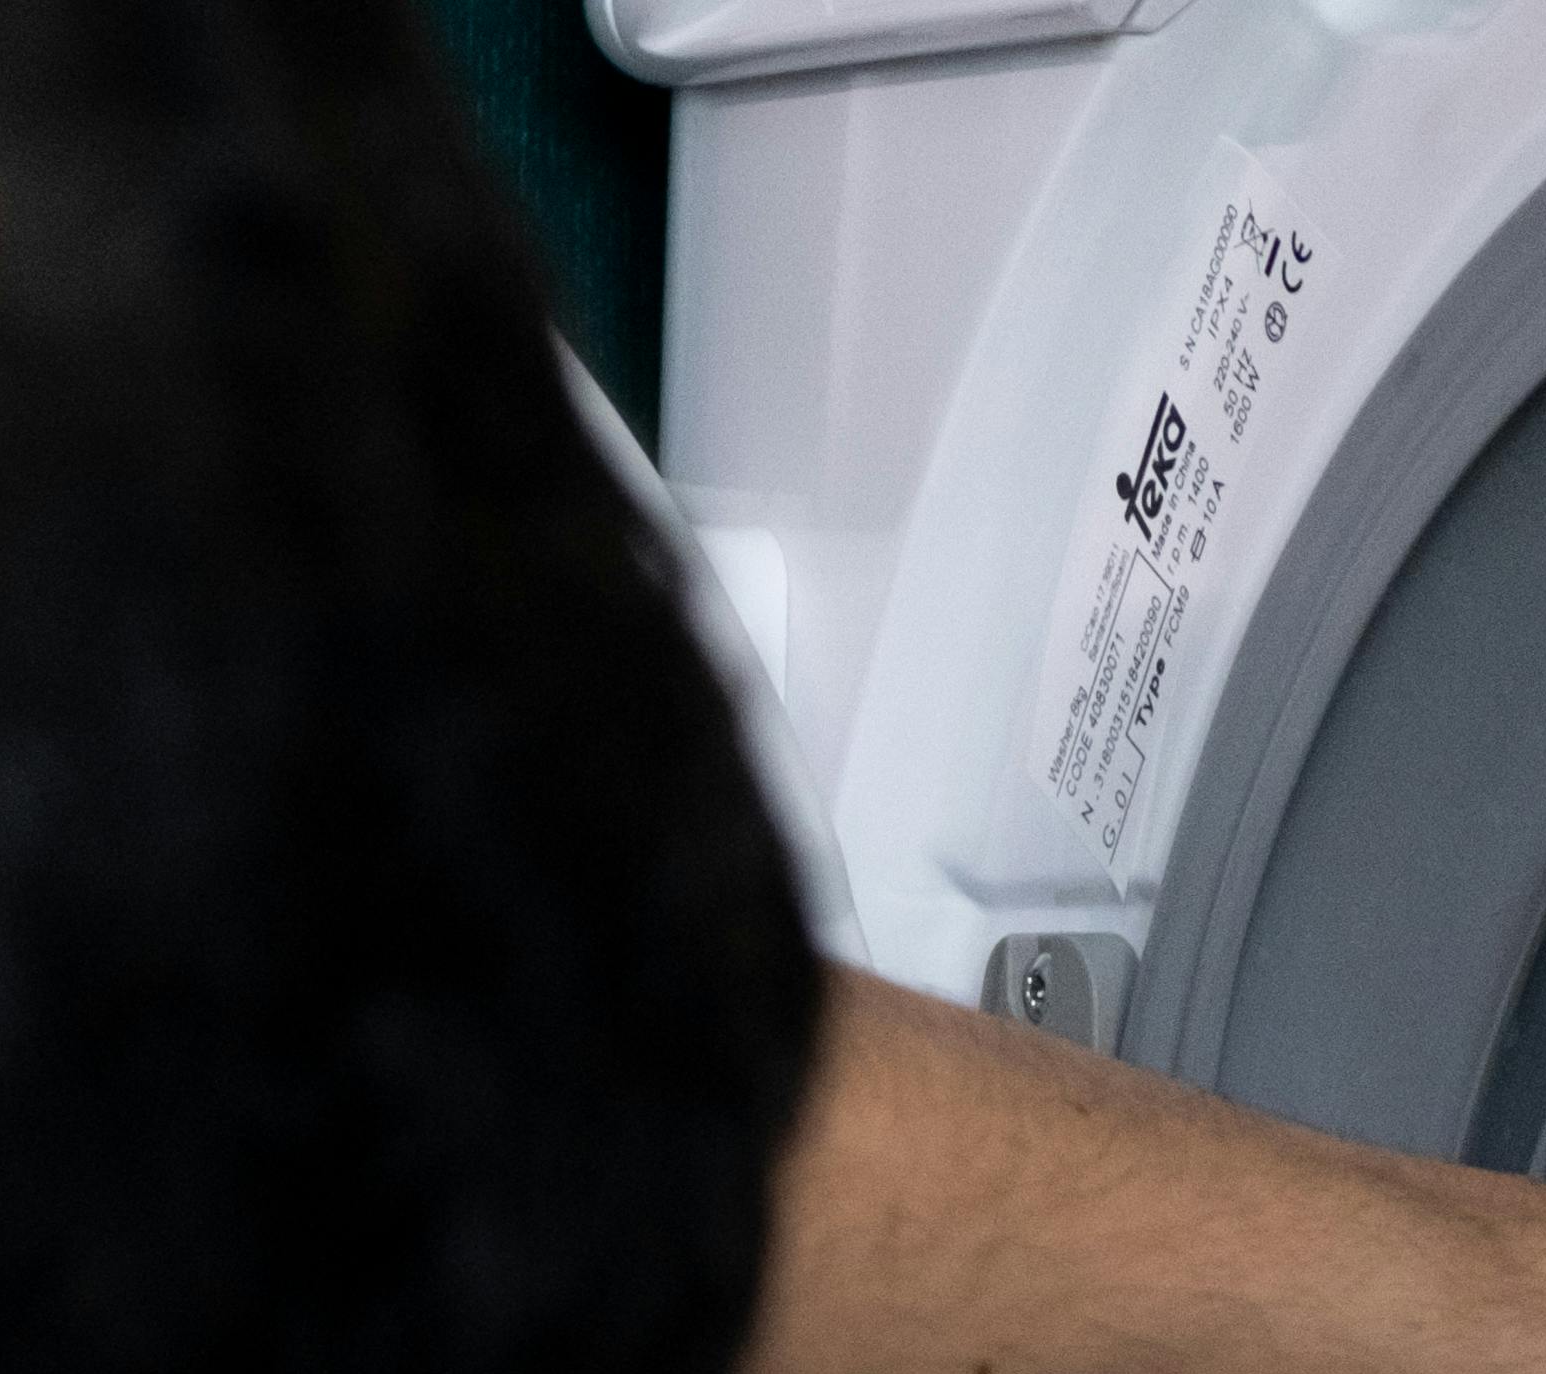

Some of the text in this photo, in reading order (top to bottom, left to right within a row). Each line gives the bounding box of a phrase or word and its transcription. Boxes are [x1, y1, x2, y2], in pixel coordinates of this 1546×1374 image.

[1207, 275, 1233, 339] IPX4
[1180, 354, 1190, 371] S
[1214, 318, 1242, 392] 220-240
[1223, 347, 1252, 418] 50 Hz
[1230, 365, 1260, 444] 1600 W
[1151, 440, 1196, 562] Made in China
[1187, 456, 1210, 507] 1400
[1203, 479, 1225, 525] 10 A
[1135, 585, 1190, 727] Type FCM9
[1047, 685, 1088, 784] Washer 8kg
[1066, 632, 1126, 797] CODE 40830071
